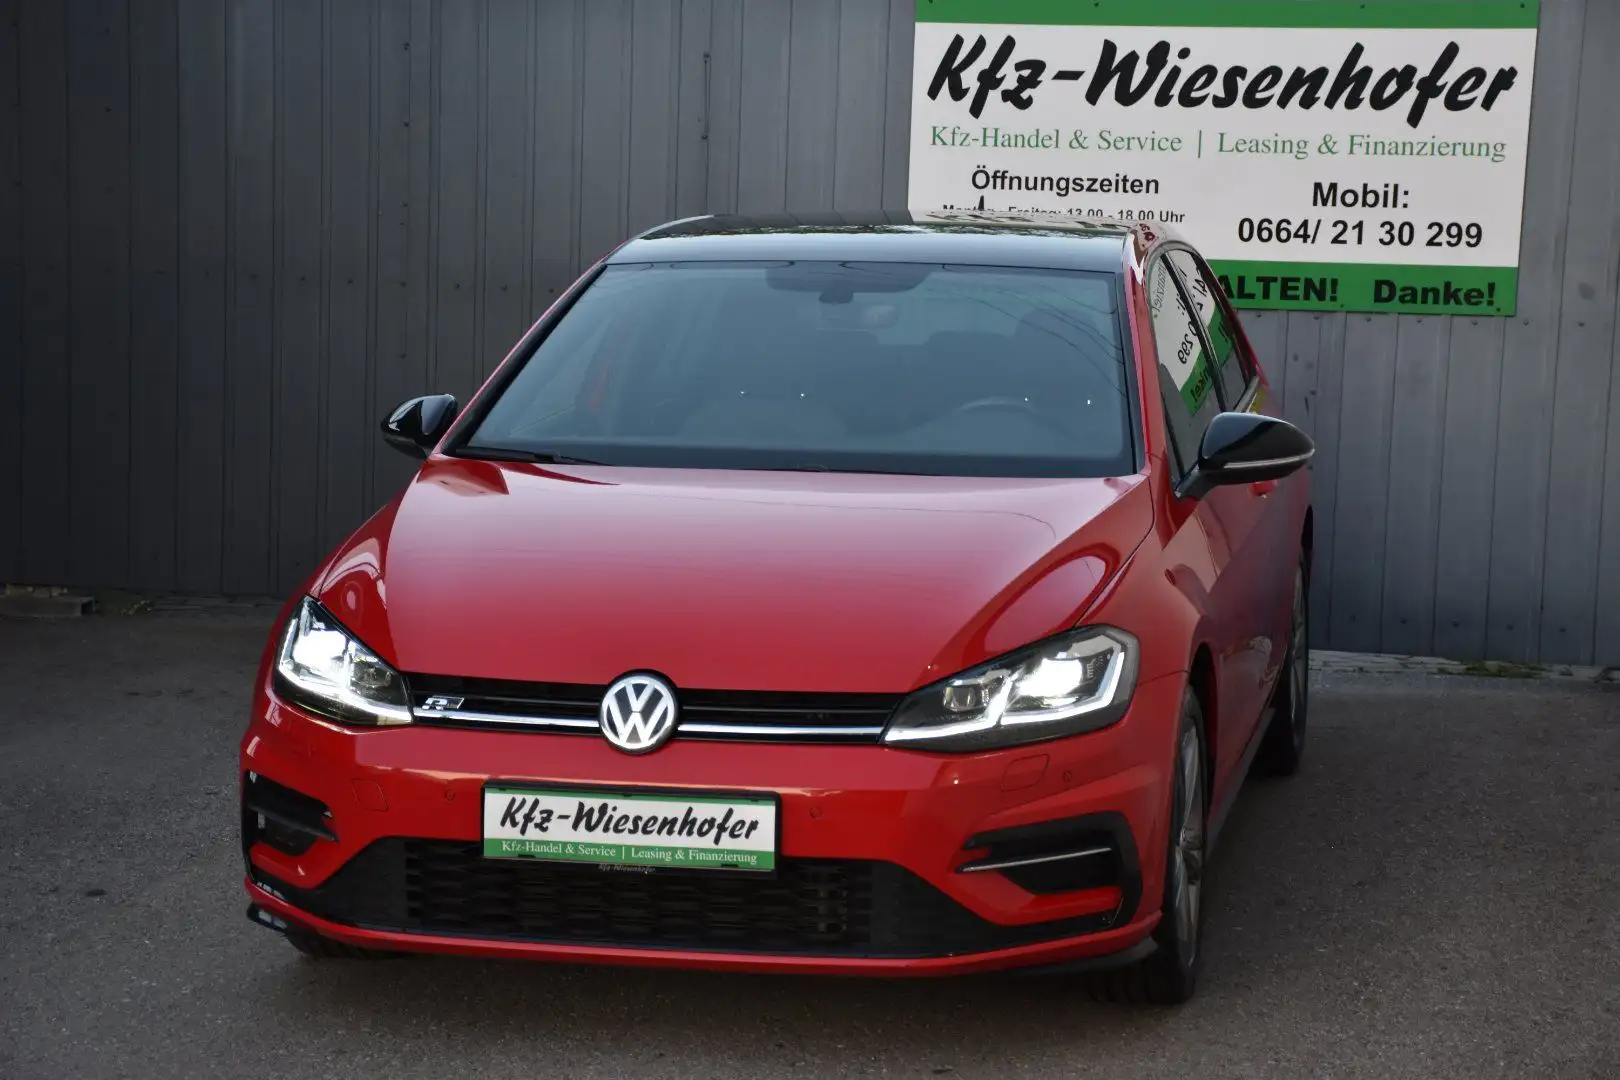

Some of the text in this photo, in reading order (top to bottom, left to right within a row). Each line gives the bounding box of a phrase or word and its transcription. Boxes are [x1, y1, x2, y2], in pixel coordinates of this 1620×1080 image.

[927, 33, 1518, 129] Kfz-Wiesenhofer
[930, 125, 1060, 149] Kfz-Handel
[1069, 129, 1088, 150] &
[1097, 130, 1182, 151] Service
[1218, 133, 1309, 160] Leasing
[1317, 134, 1339, 155] &
[1347, 134, 1507, 163] Finanzierung
[971, 165, 1160, 197] Öffnungszeiten
[1312, 182, 1409, 209] Mobil:
[1117, 209, 1155, 221] 1800
[1159, 210, 1186, 223] Uhr
[1238, 217, 1483, 248] 0664/ 21 30 299
[1374, 278, 1496, 307] Danke!
[601, 675, 676, 748] VW
[500, 796, 759, 846] Kfz-Wiesenhofer
[502, 840, 562, 853] Kfz-Handel
[565, 842, 575, 854] &
[578, 844, 616, 857] Service
[631, 847, 672, 862] Leasing
[675, 849, 685, 860] &
[689, 849, 757, 865] Finanzierung
